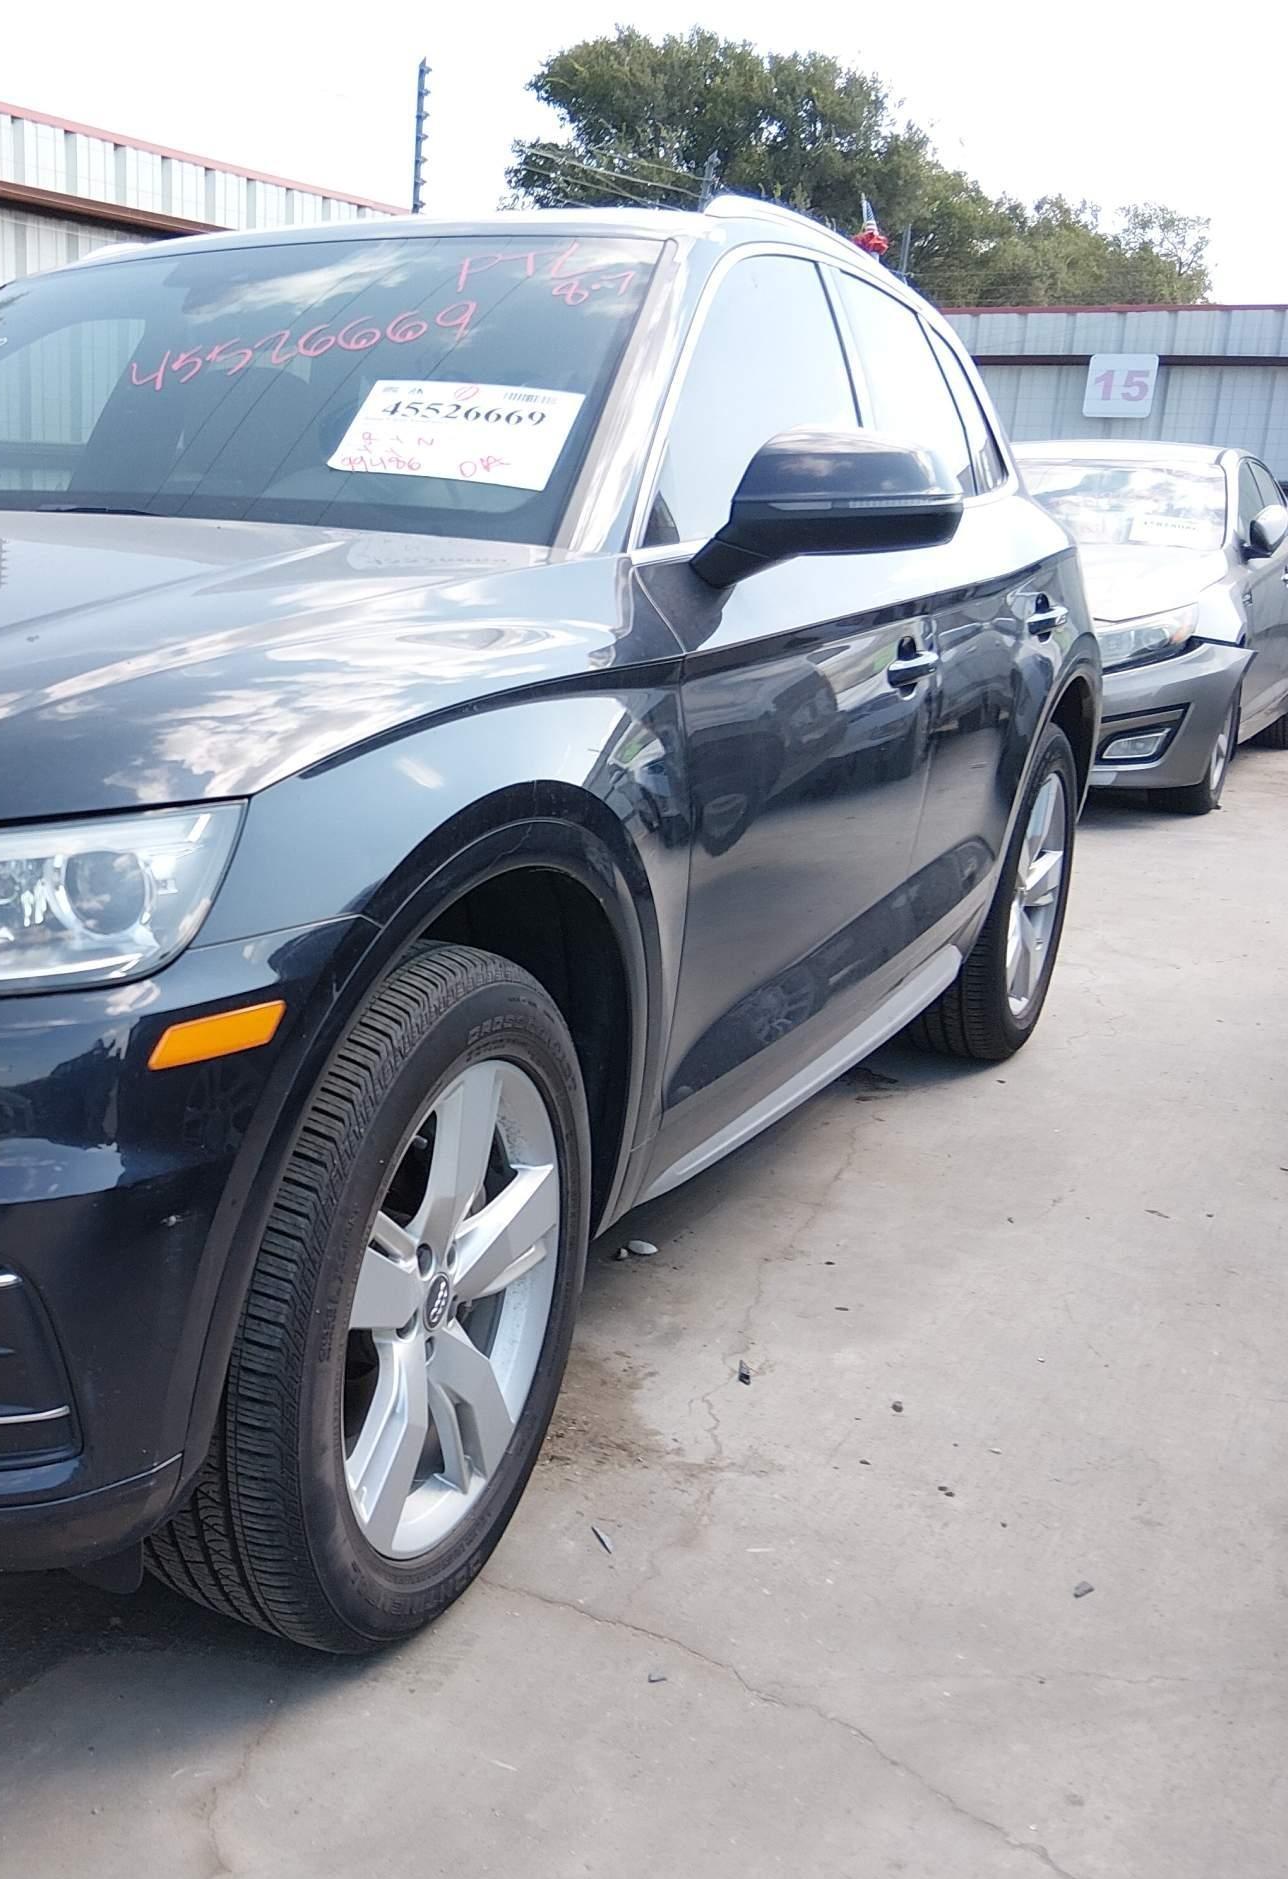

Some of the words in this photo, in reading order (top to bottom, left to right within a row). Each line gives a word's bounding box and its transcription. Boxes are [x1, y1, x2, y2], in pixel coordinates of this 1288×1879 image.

[131, 301, 477, 391] 45526669
[1094, 369, 1151, 401] 15
[381, 400, 547, 426] 45526669
